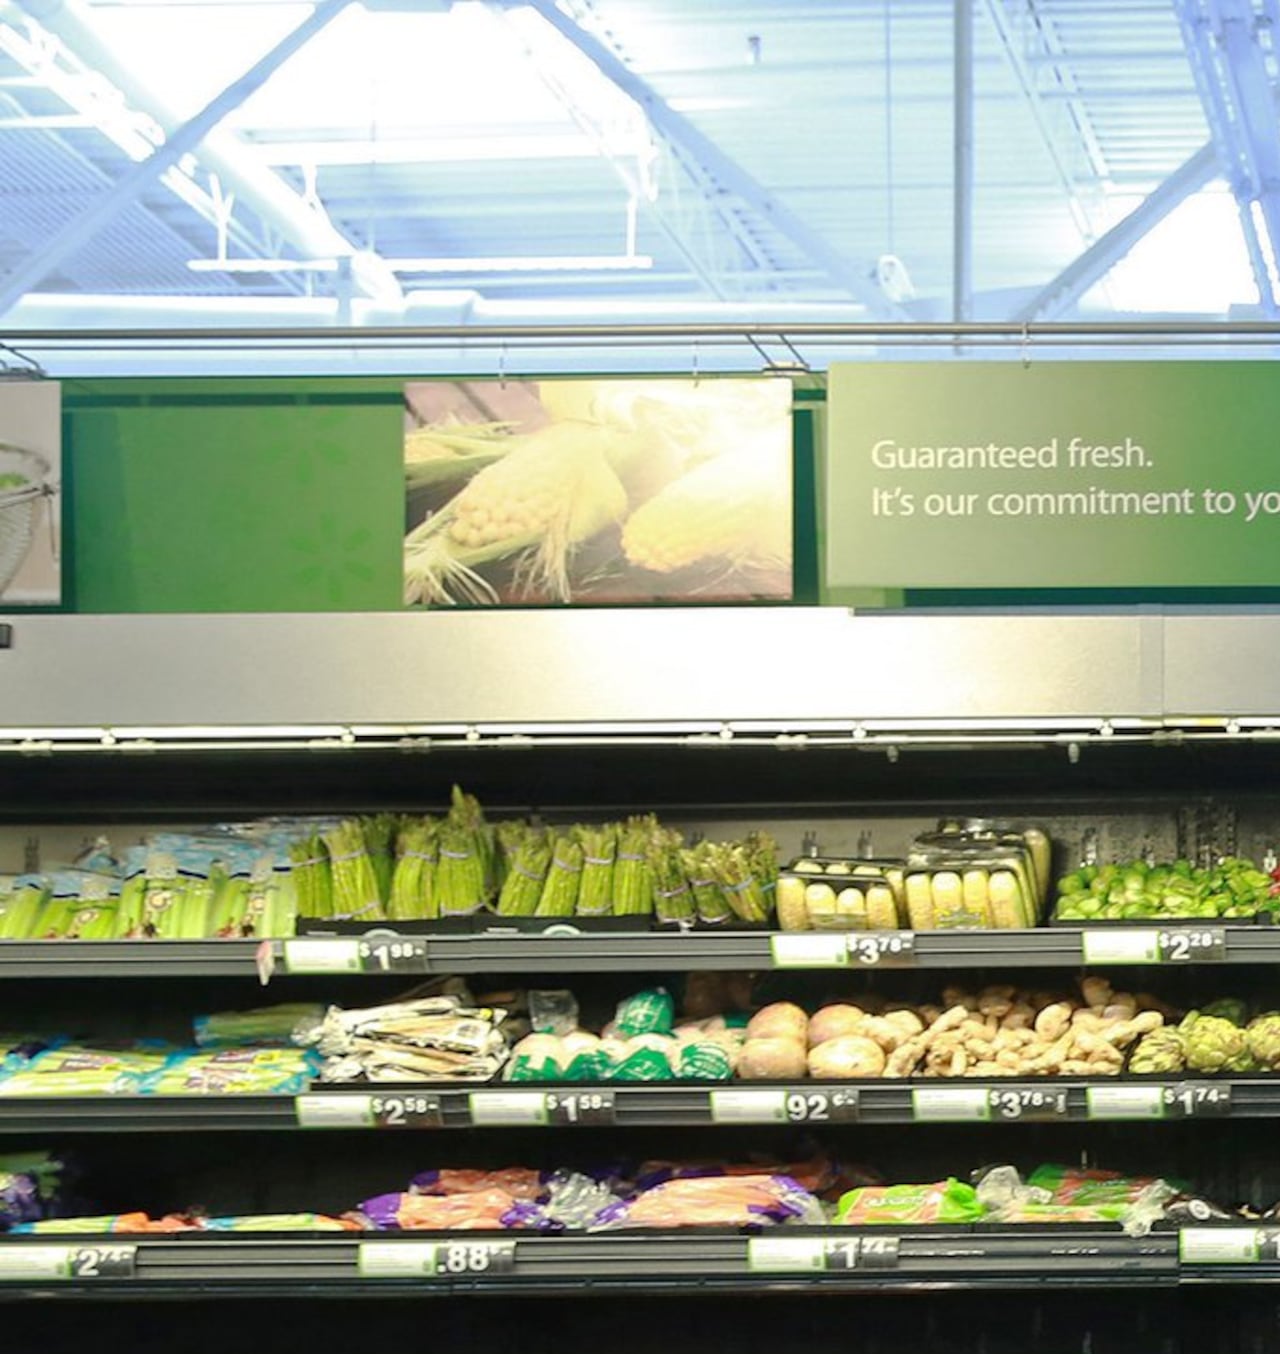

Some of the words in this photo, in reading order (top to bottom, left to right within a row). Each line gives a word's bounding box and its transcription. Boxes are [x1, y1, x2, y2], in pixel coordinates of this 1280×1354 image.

[871, 437, 1058, 469] Guaranteed
[1067, 437, 1154, 468] fresh.
[872, 486, 915, 516] It's
[924, 493, 979, 516] our
[987, 486, 1195, 516] commitment
[1202, 488, 1236, 514] to
